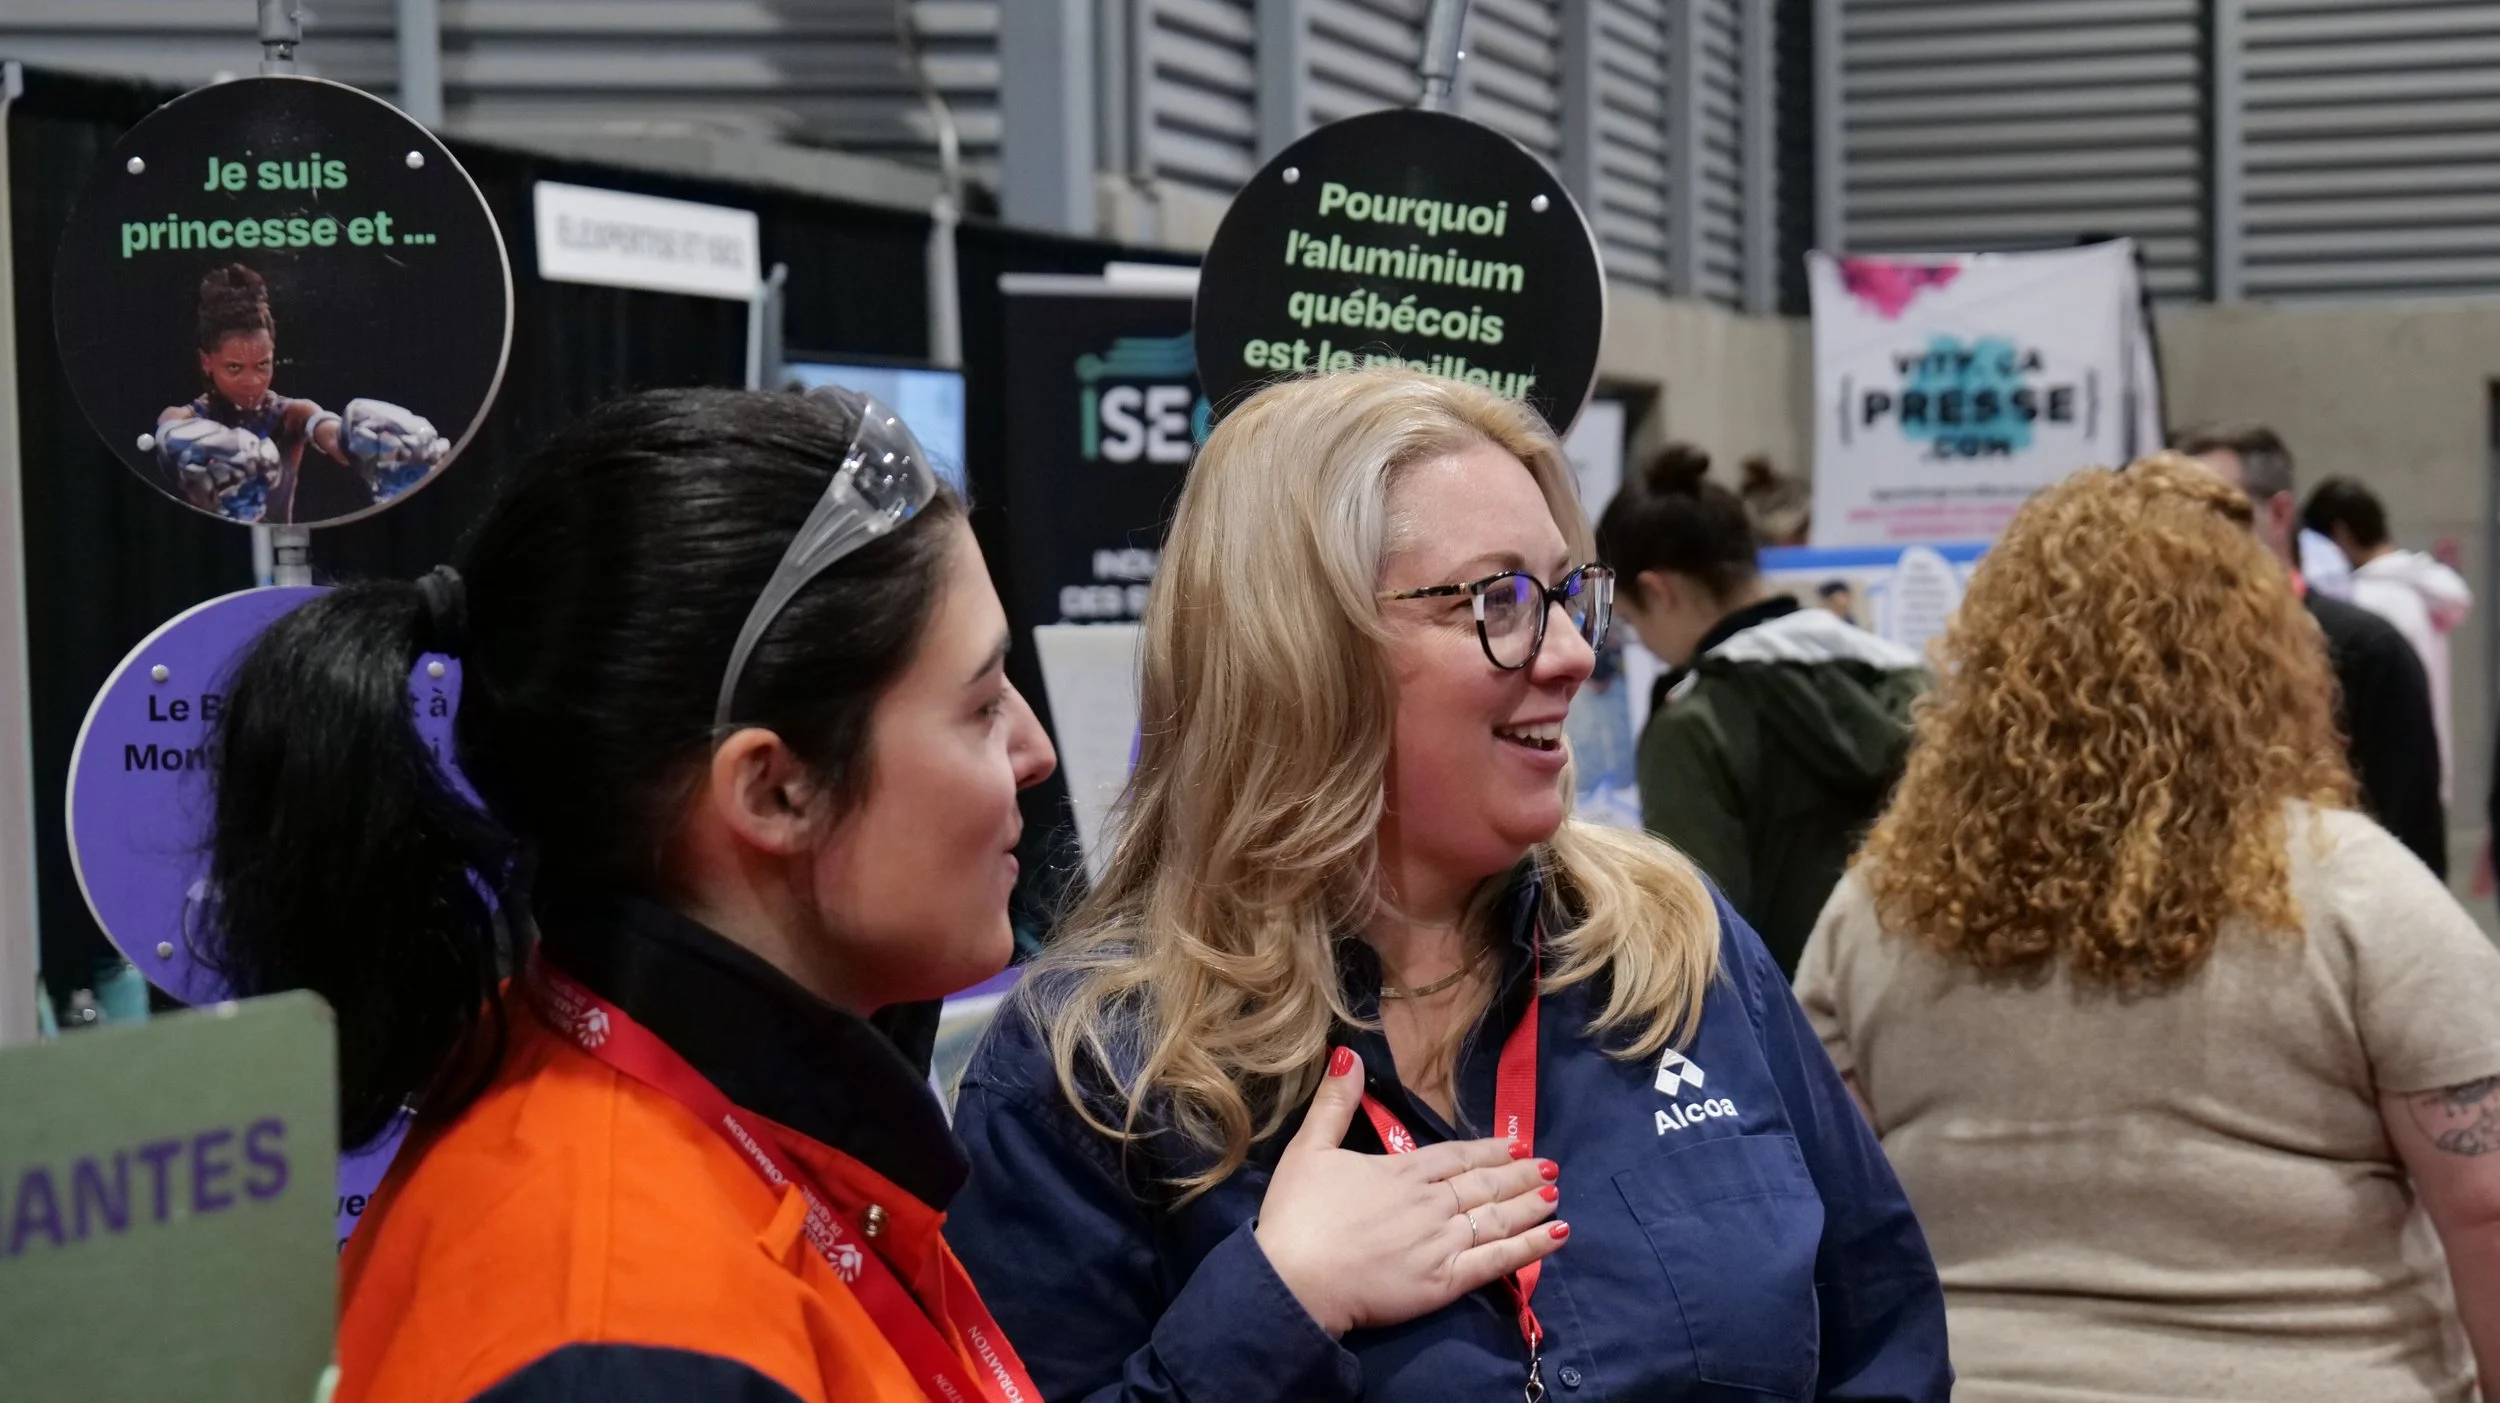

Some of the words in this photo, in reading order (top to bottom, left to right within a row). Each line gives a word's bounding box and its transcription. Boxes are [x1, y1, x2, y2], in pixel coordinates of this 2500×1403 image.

[204, 156, 248, 191] Je
[257, 152, 348, 190] suis
[1318, 181, 1508, 237] Pourquoi
[122, 213, 338, 258] princesse
[347, 211, 394, 246] et
[1285, 229, 1525, 293] l'aluminium
[1288, 287, 1504, 345] québécois
[1244, 338, 1311, 371] est
[1318, 340, 1354, 373] le
[1074, 354, 1211, 463] iSE
[1863, 384, 2077, 427] PRESSE
[148, 694, 190, 722] Le
[1654, 1098, 1739, 1136] Alcoa
[0, 1115, 289, 1258] ANTES
